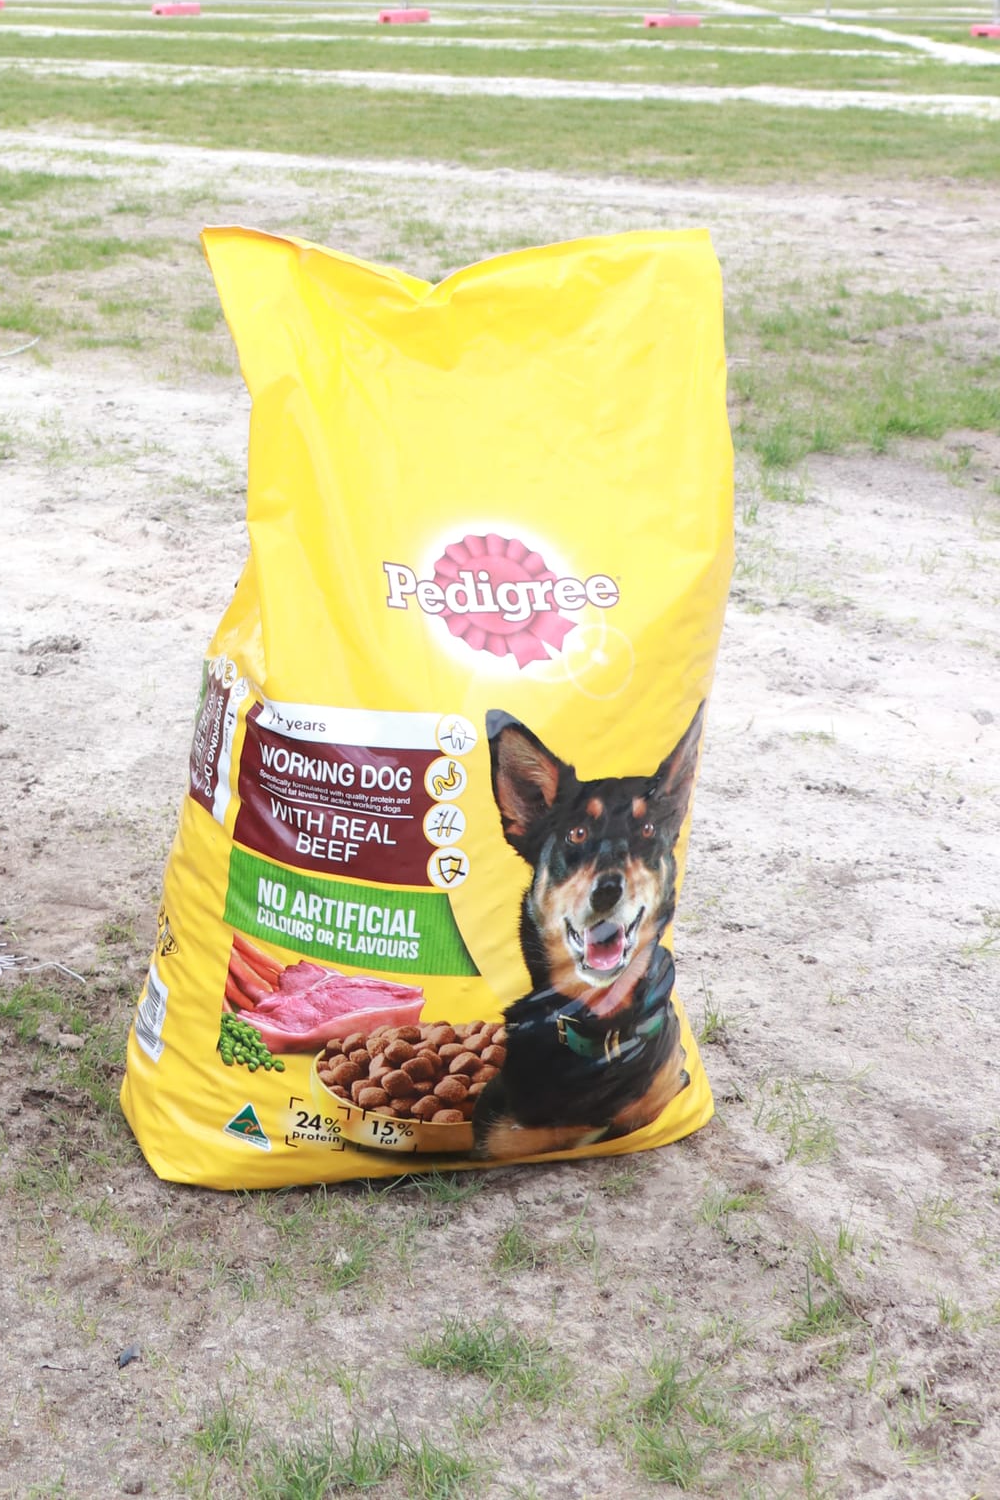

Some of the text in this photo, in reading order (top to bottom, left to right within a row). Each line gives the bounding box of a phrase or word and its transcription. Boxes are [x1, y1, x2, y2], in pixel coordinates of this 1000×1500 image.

[383, 561, 620, 623] Pedigree
[207, 695, 225, 763] WORKING
[286, 720, 326, 732] years
[259, 742, 412, 791] WORKING DOG
[292, 781, 328, 794] formulated
[345, 793, 369, 803] quality
[370, 796, 395, 804] protein
[298, 790, 318, 799] levels
[353, 801, 381, 811] working
[382, 805, 401, 813] dogs
[271, 797, 397, 845] WITH REAL
[296, 832, 360, 862] BEEF
[257, 877, 421, 938] NO ARTIFICIAL
[257, 906, 419, 960] COLOURS OR FLAVOURS
[295, 1111, 342, 1134] 24%
[371, 1120, 415, 1137] 15%
[292, 1130, 340, 1143] protein
[379, 1136, 398, 1145] fat
